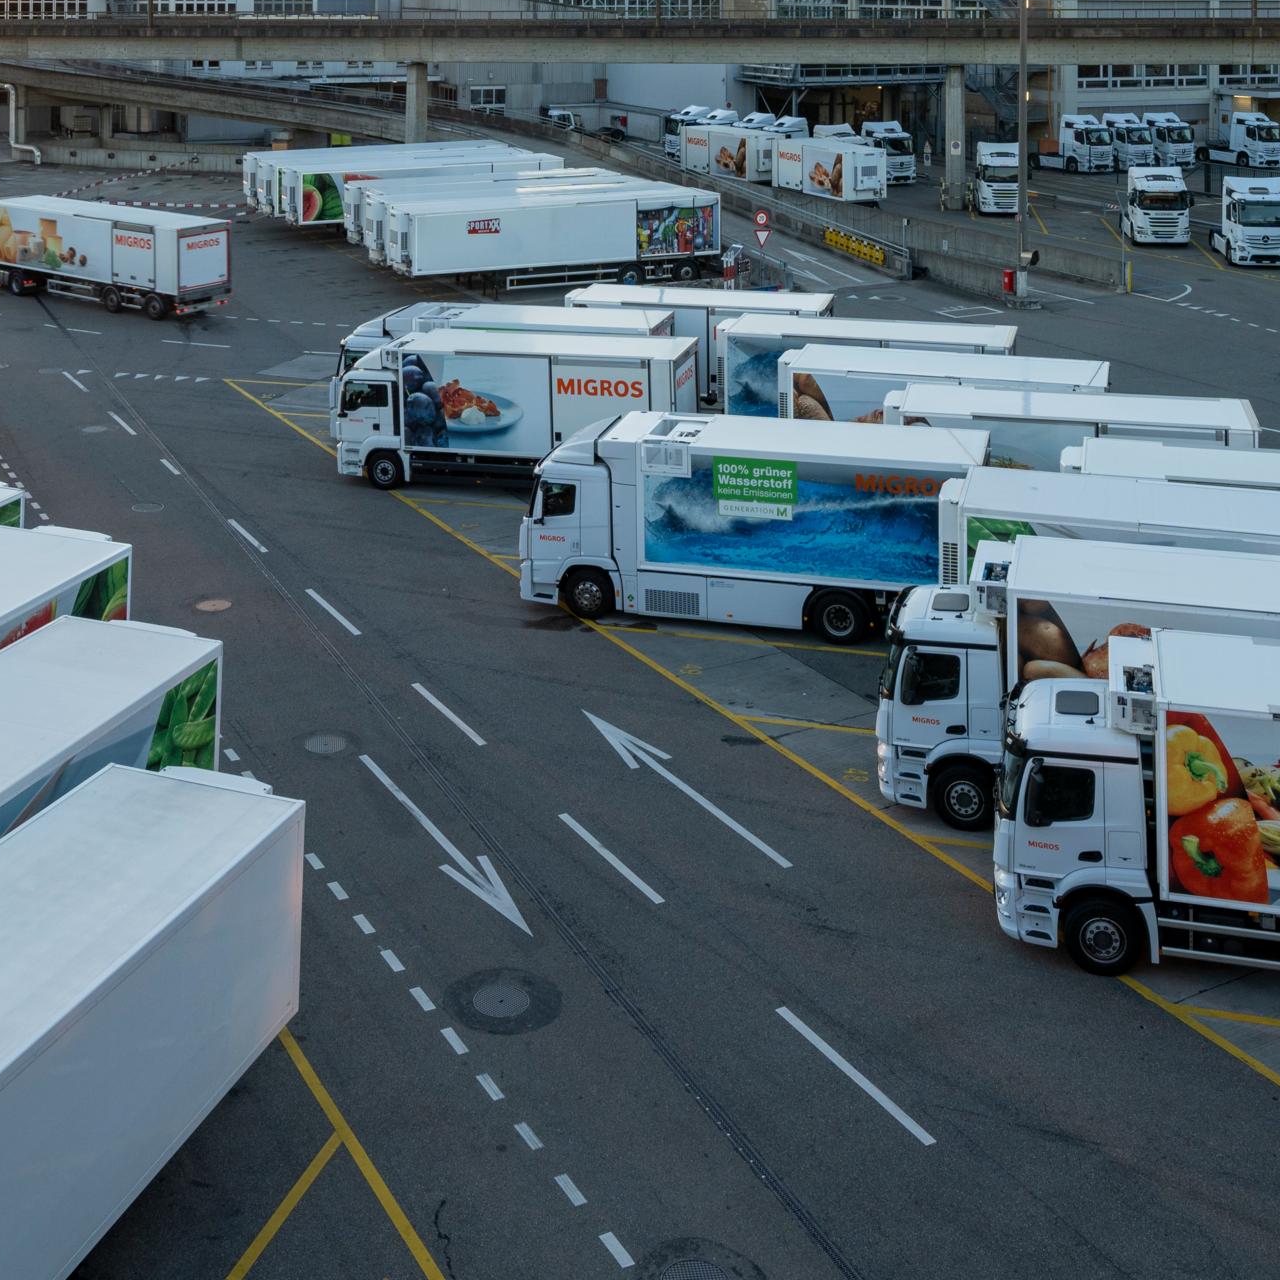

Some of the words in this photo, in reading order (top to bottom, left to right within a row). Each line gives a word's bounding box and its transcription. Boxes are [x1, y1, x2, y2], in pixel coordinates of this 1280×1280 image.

[687, 136, 708, 147] MIGROS
[778, 151, 802, 163] MIGROS
[115, 233, 152, 251] MIGROS
[186, 236, 221, 251] MIGROS
[556, 377, 644, 399] MIGROS
[717, 463, 749, 476] 100%
[753, 466, 793, 482] grüner
[718, 474, 793, 490] Wasserstoff
[854, 473, 941, 498] MIGRO
[718, 486, 741, 497] keine
[743, 487, 793, 500] Emissionen
[723, 504, 775, 515] GENERATION
[776, 506, 788, 518] M
[539, 534, 566, 543] MIGROS
[912, 716, 941, 726] MIGROS
[1027, 839, 1061, 852] MIGROS
